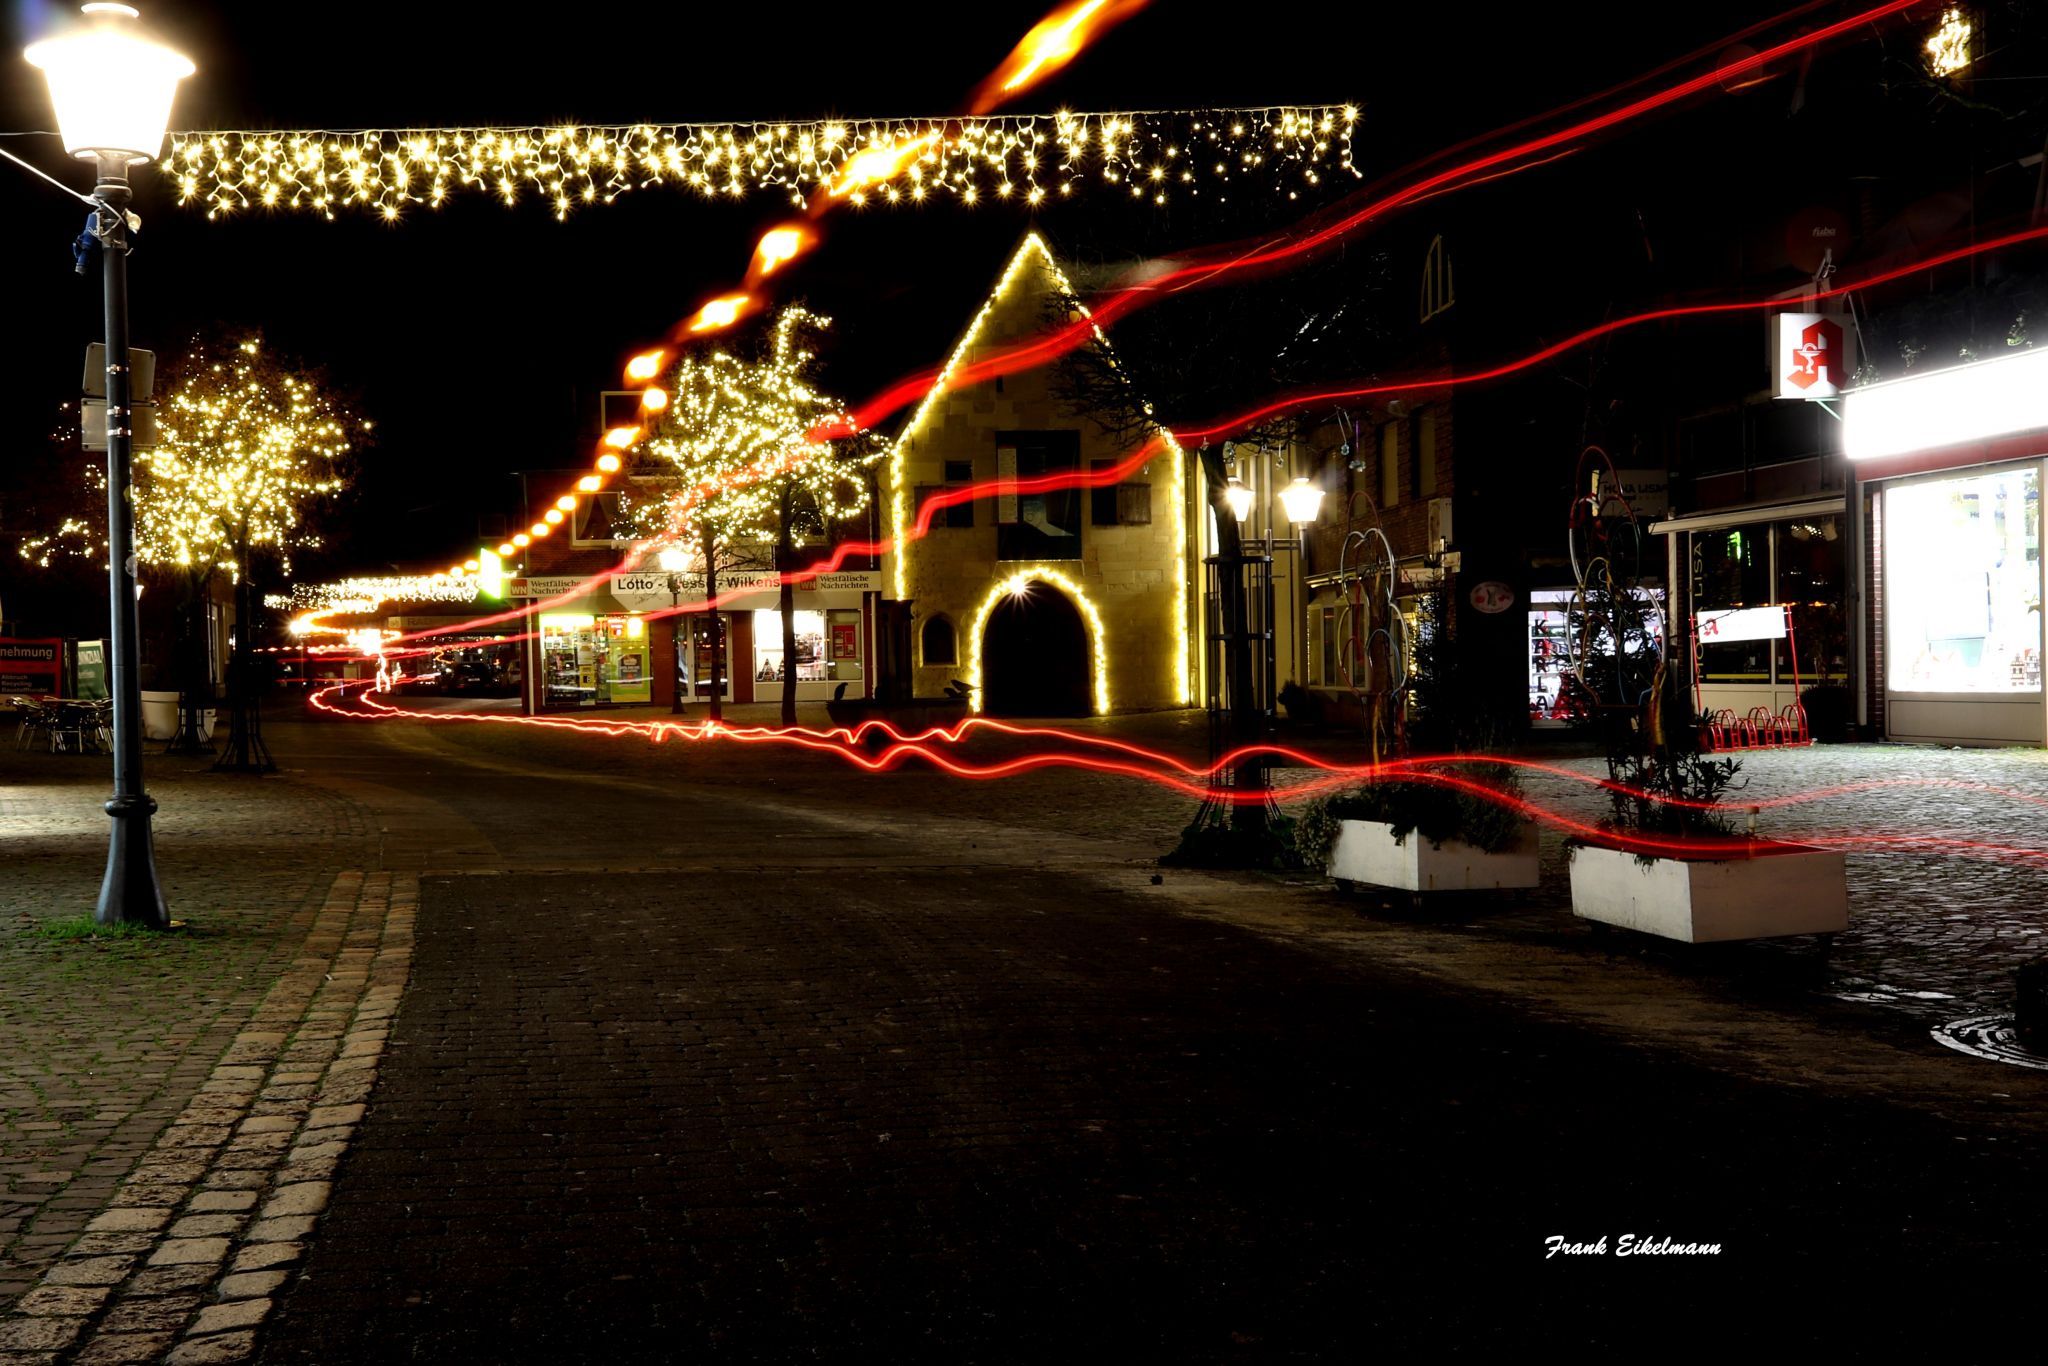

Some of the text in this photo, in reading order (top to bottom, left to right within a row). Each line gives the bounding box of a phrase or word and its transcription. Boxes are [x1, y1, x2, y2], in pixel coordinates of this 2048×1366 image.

[1693, 541, 1703, 598] LISA
[820, 574, 869, 582] Westfälische
[617, 578, 654, 590] Lotto
[727, 576, 781, 588] Wilkens
[821, 582, 869, 590] Nachrichten
[511, 586, 528, 595] WN
